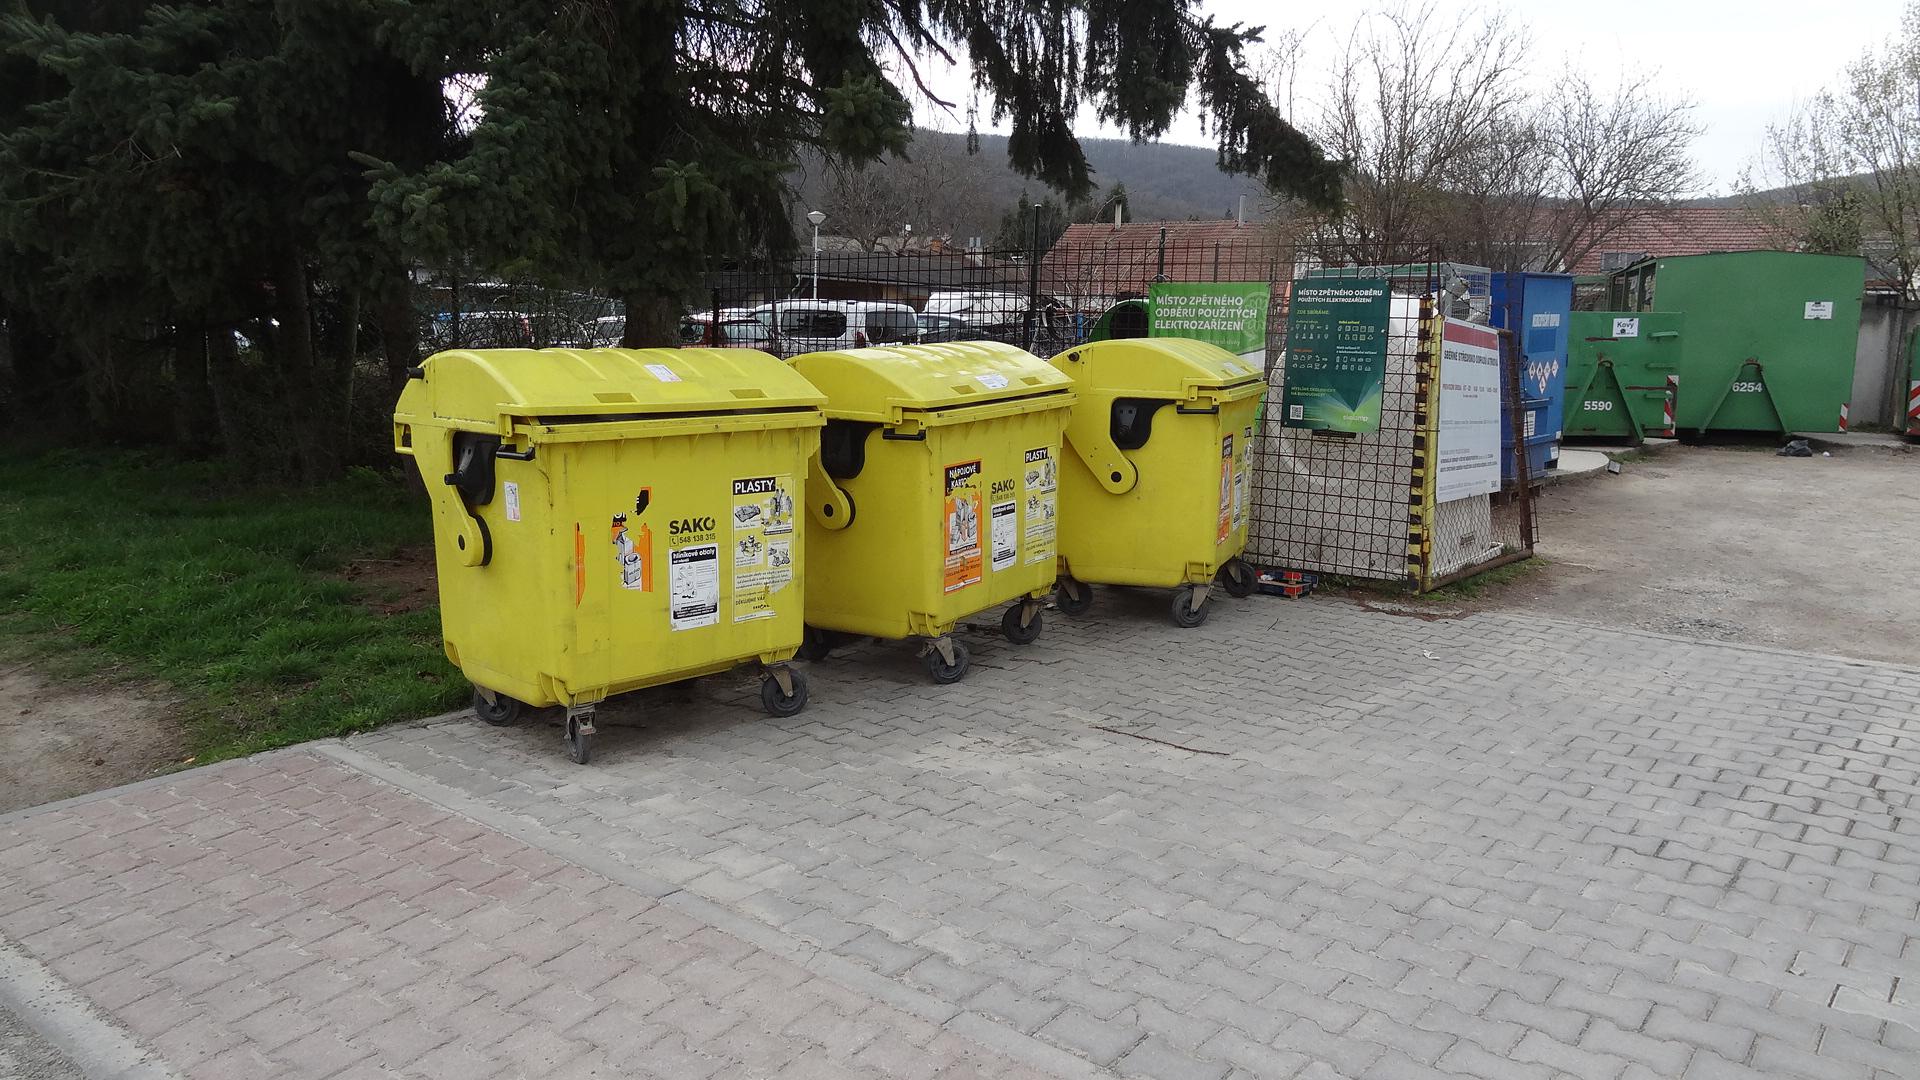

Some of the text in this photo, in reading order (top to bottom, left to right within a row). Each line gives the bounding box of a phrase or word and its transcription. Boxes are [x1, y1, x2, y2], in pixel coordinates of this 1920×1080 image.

[1298, 288, 1382, 296] MÍSTO ZPĚTNÉHO ODBĚRU
[1156, 294, 1244, 306] MÍSTO ZPĚTNÉHO
[1155, 306, 1257, 318] ODBĚRU POUŽITÝCH
[1154, 319, 1244, 330] ELEKTROZAŘÍZENÍ
[1732, 382, 1762, 392] 6254
[1584, 401, 1613, 411] 5590
[1026, 450, 1046, 462] PLASTY
[735, 480, 774, 493] PLASTY
[992, 479, 1015, 494] SAKO
[670, 516, 716, 534] SAKO
